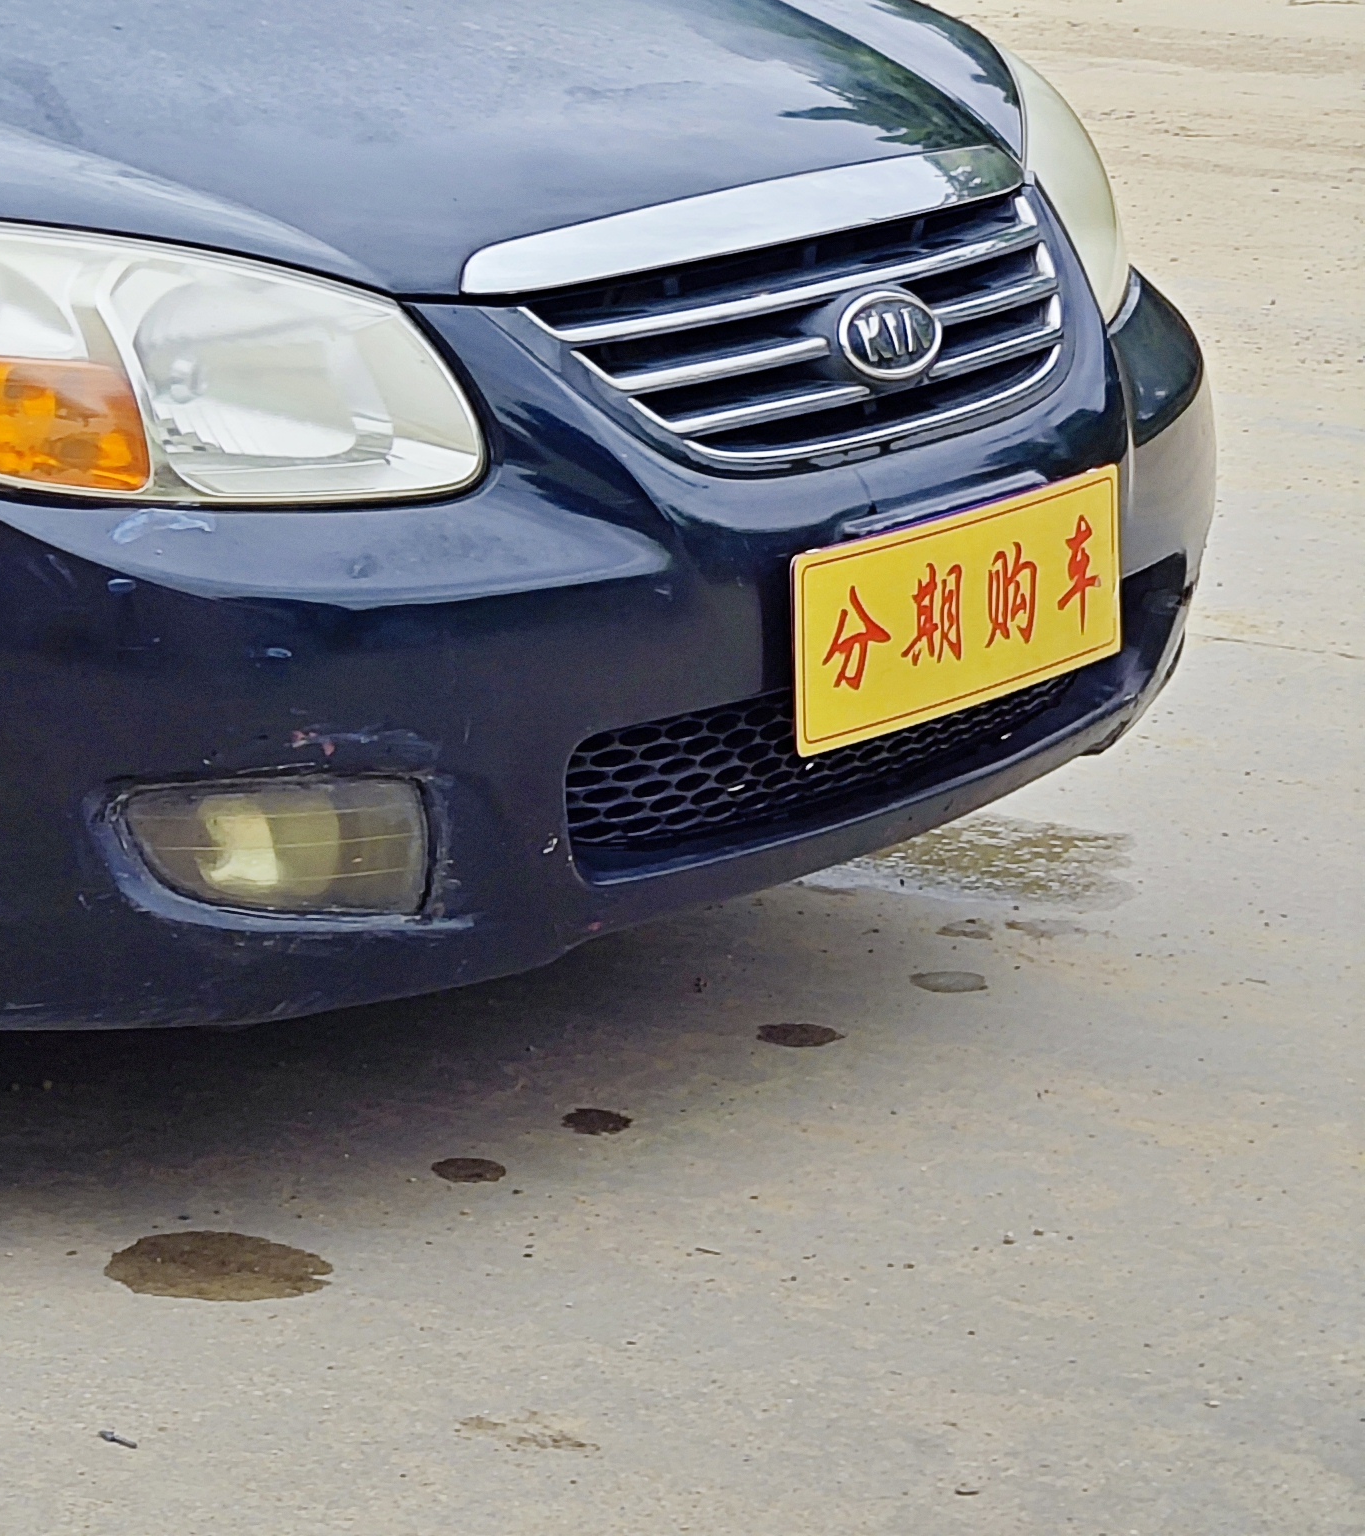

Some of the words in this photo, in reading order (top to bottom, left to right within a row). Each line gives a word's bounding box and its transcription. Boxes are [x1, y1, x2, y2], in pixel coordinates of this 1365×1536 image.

[852, 306, 934, 363] KIA
[821, 513, 1102, 691] 分期购车
